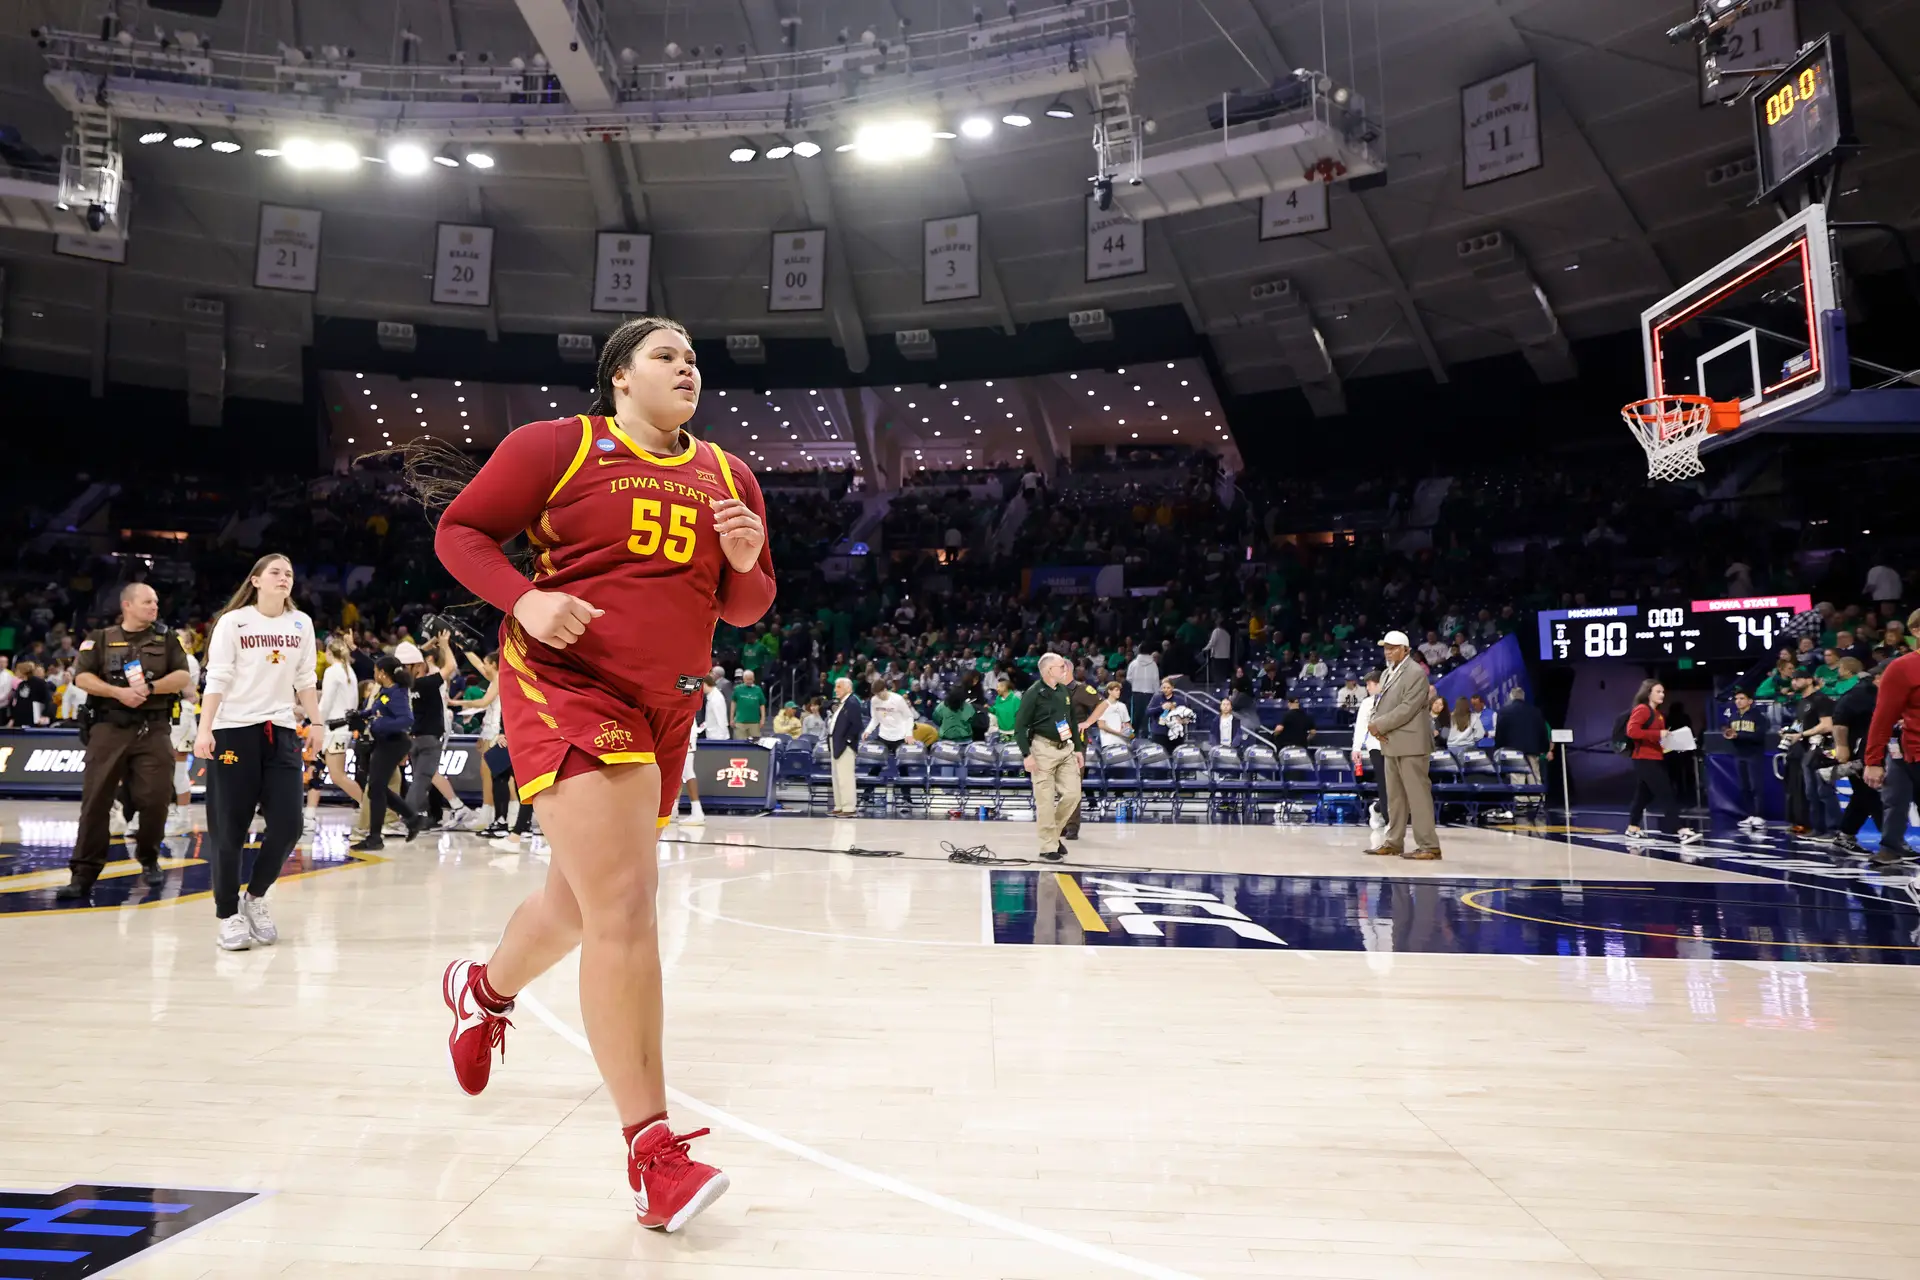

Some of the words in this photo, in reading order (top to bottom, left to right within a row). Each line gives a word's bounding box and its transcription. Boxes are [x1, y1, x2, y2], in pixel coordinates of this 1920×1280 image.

[1728, 27, 1764, 62] 21
[1766, 68, 1817, 125] 00.0
[1488, 125, 1511, 152] 11
[1286, 190, 1298, 208] 4
[1104, 234, 1125, 254] 44
[276, 248, 297, 267] 21
[452, 264, 474, 283] 20
[946, 260, 956, 277] 3
[611, 273, 632, 290] 33
[785, 271, 807, 288] 00
[610, 477, 660, 493] IOWA
[627, 498, 698, 564] 55
[1567, 607, 1618, 618] MICHIGAN
[1709, 601, 1741, 610] IOWA
[1743, 598, 1778, 608] STATE
[1584, 622, 1628, 657] 80
[1725, 615, 1773, 650] 74
[240, 634, 285, 649] NOTHING
[1663, 642, 1673, 654] 4
[1559, 645, 1568, 659] 3
[716, 766, 759, 782] STATE
